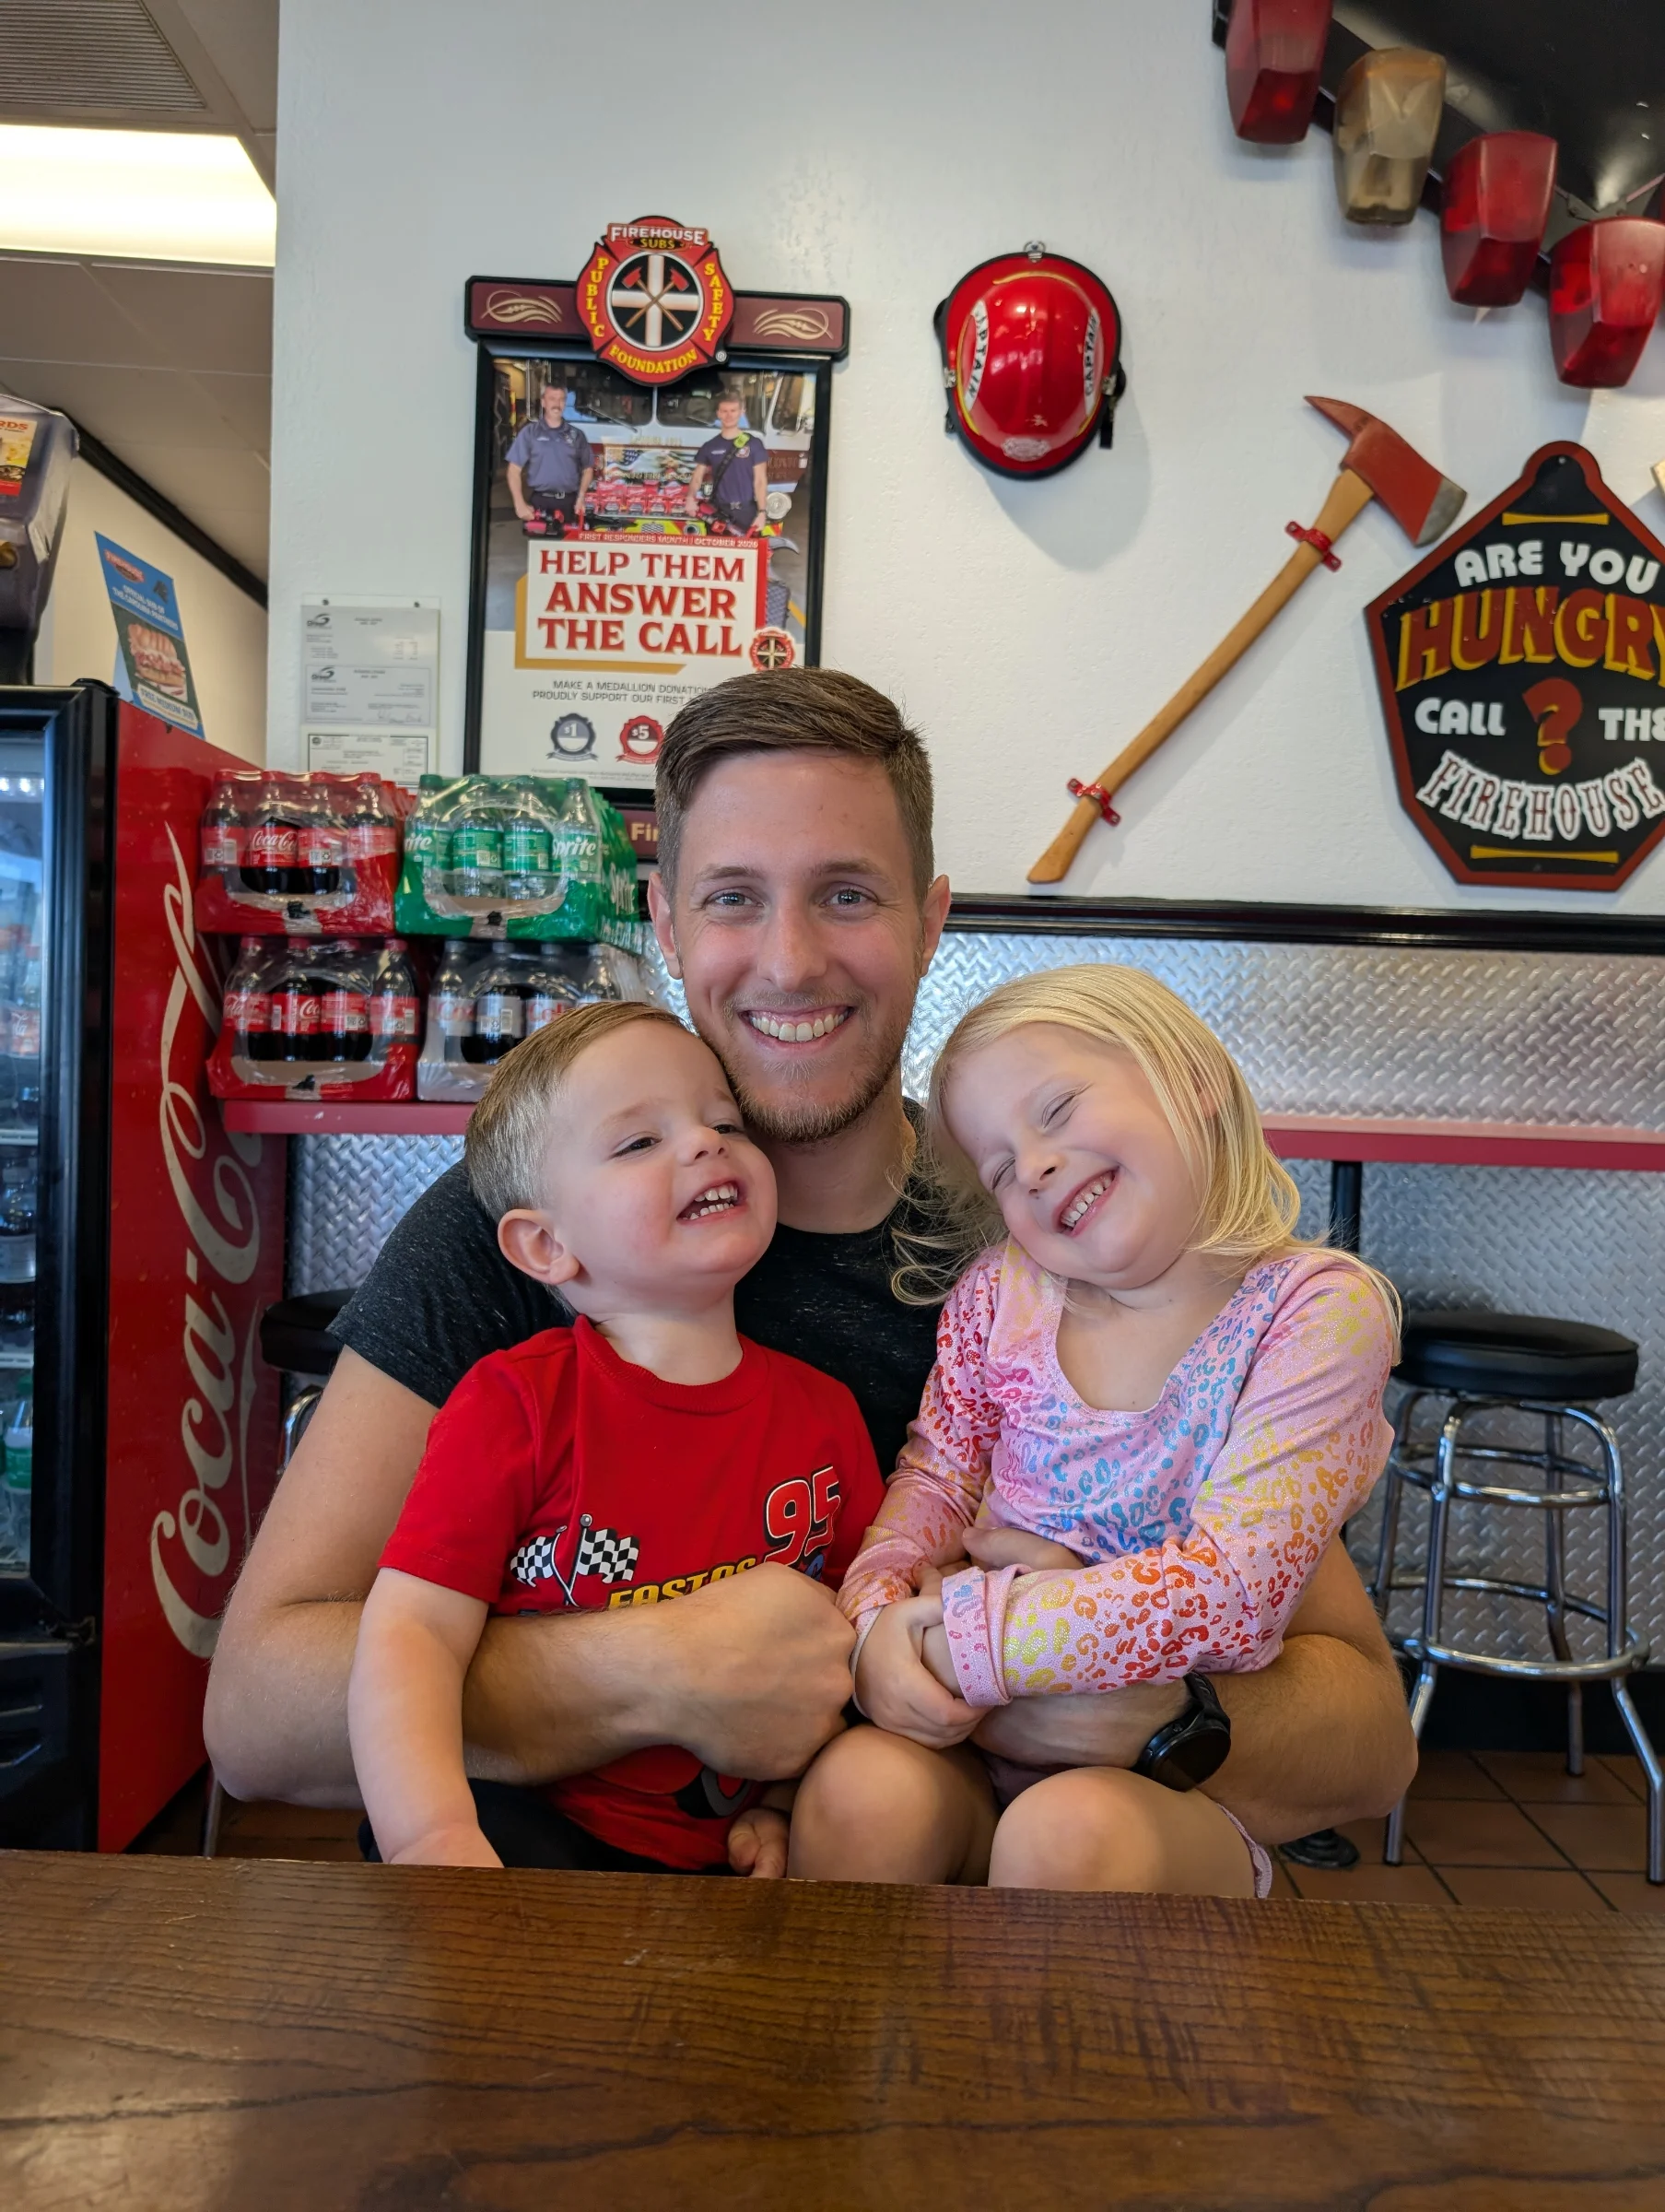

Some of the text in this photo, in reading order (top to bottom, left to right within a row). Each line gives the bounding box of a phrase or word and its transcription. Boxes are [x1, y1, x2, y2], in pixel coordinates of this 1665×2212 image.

[611, 227, 706, 246] FIREHOUSE
[639, 239, 675, 249] SUBS
[586, 257, 609, 337] PUBLIC
[702, 263, 723, 342] SAFETY
[609, 344, 698, 374] FOUNDATION
[579, 533, 602, 542] FIRST
[694, 537, 735, 547] OCTOBER
[540, 550, 745, 582] HELP THEM
[1454, 539, 1660, 594] ARE YOU
[545, 582, 736, 619] ANSWER
[537, 618, 743, 658] THE CALL
[533, 691, 685, 704] PROUDLY SUPPORT OUR FIRST
[553, 681, 582, 690] MAKE
[586, 682, 593, 690] A
[597, 682, 656, 692] MEDALLION
[632, 724, 650, 740] $5
[1414, 697, 1506, 735] CALL
[1416, 750, 1665, 841] FIREHOUSE
[552, 836, 597, 860] Sprite
[764, 1465, 840, 1567] 95
